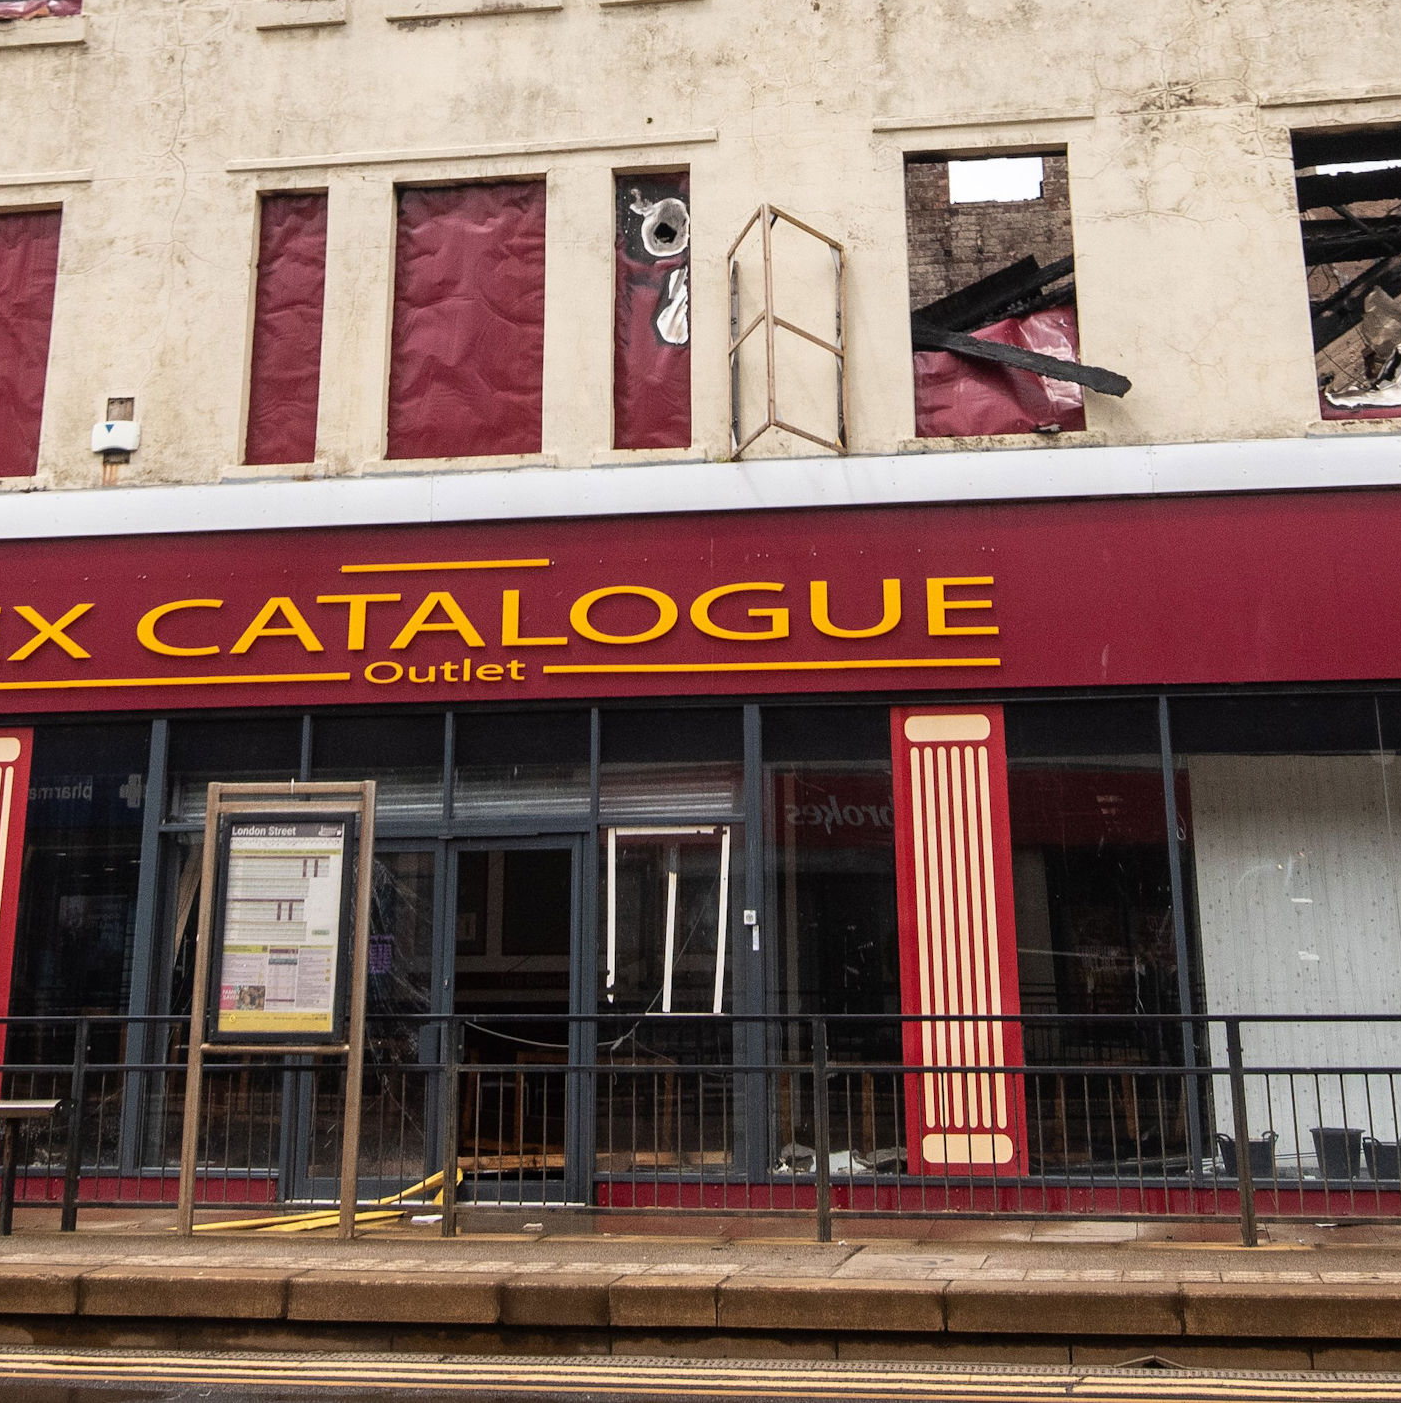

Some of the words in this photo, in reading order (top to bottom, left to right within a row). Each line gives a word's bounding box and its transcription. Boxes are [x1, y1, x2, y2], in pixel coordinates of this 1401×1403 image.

[136, 576, 999, 657] CATALOGUE
[364, 658, 526, 684] Outlet
[232, 825, 266, 836] London
[268, 825, 297, 836] Street
